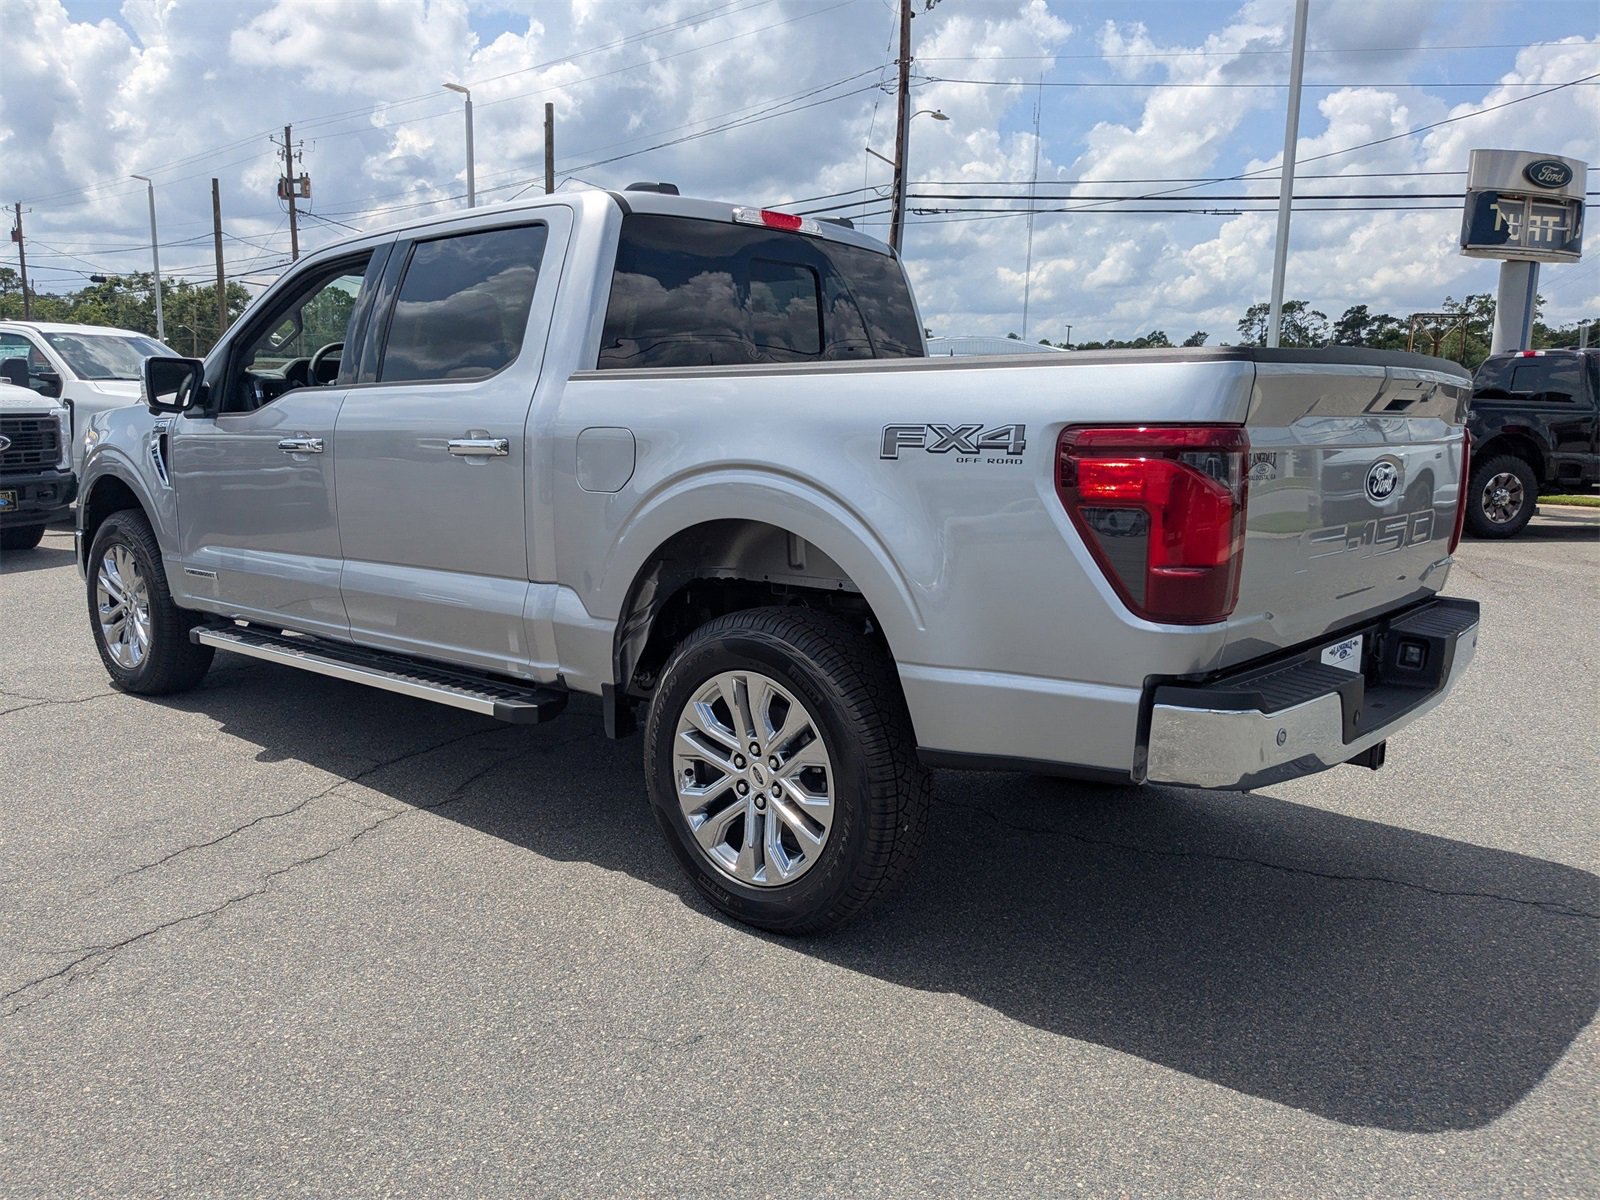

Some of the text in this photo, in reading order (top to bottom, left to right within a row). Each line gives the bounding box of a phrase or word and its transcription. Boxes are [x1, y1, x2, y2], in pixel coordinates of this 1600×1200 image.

[1538, 165, 1564, 183] Ford
[880, 423, 1026, 460] FX4
[1373, 467, 1395, 494] Ford
